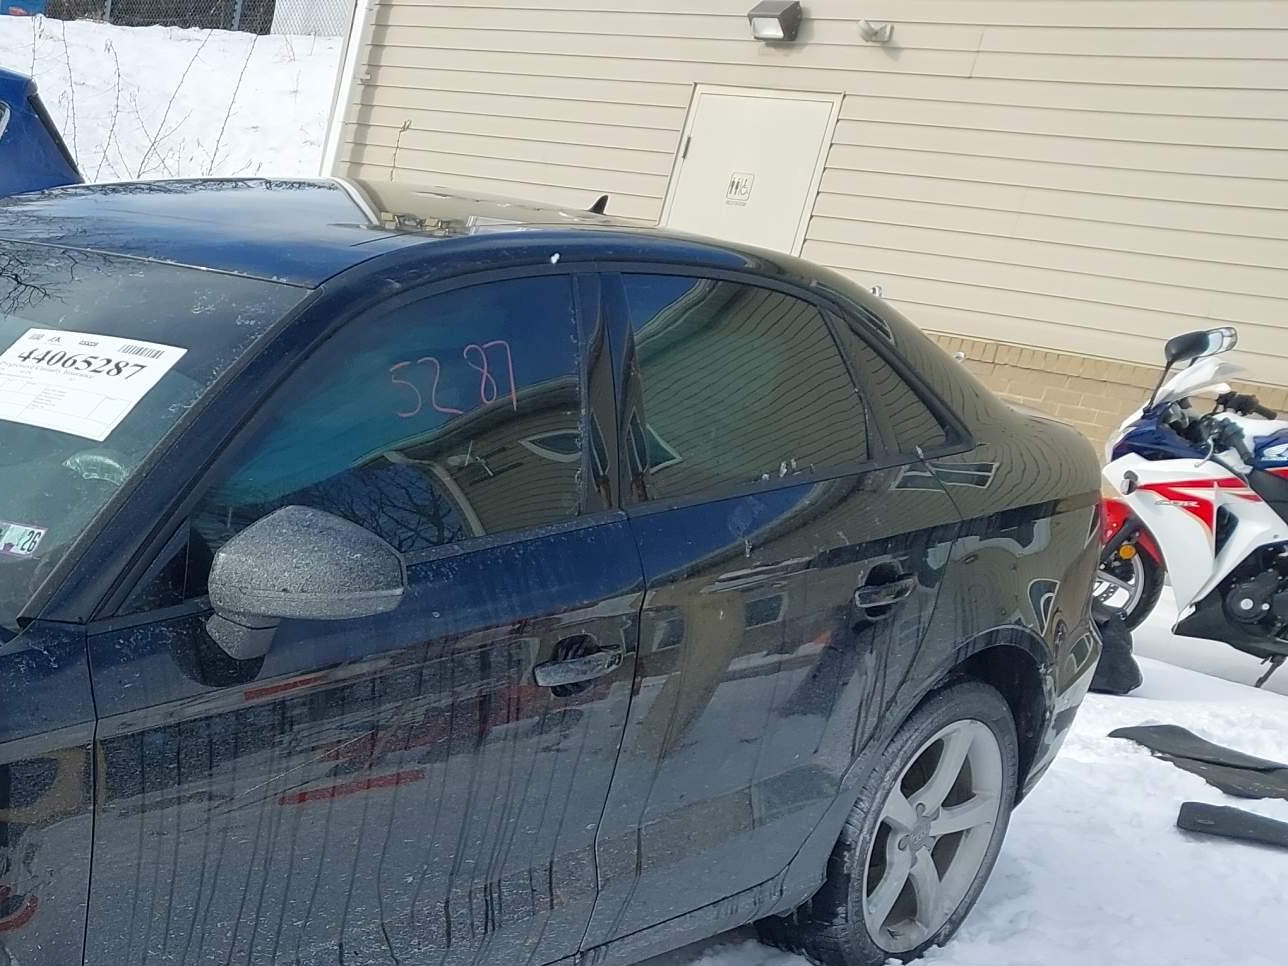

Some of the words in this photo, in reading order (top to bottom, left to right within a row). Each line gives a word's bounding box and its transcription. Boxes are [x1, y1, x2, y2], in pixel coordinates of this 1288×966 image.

[17, 347, 148, 381] 44065287
[389, 339, 518, 418] 5287
[19, 530, 42, 553] 26
